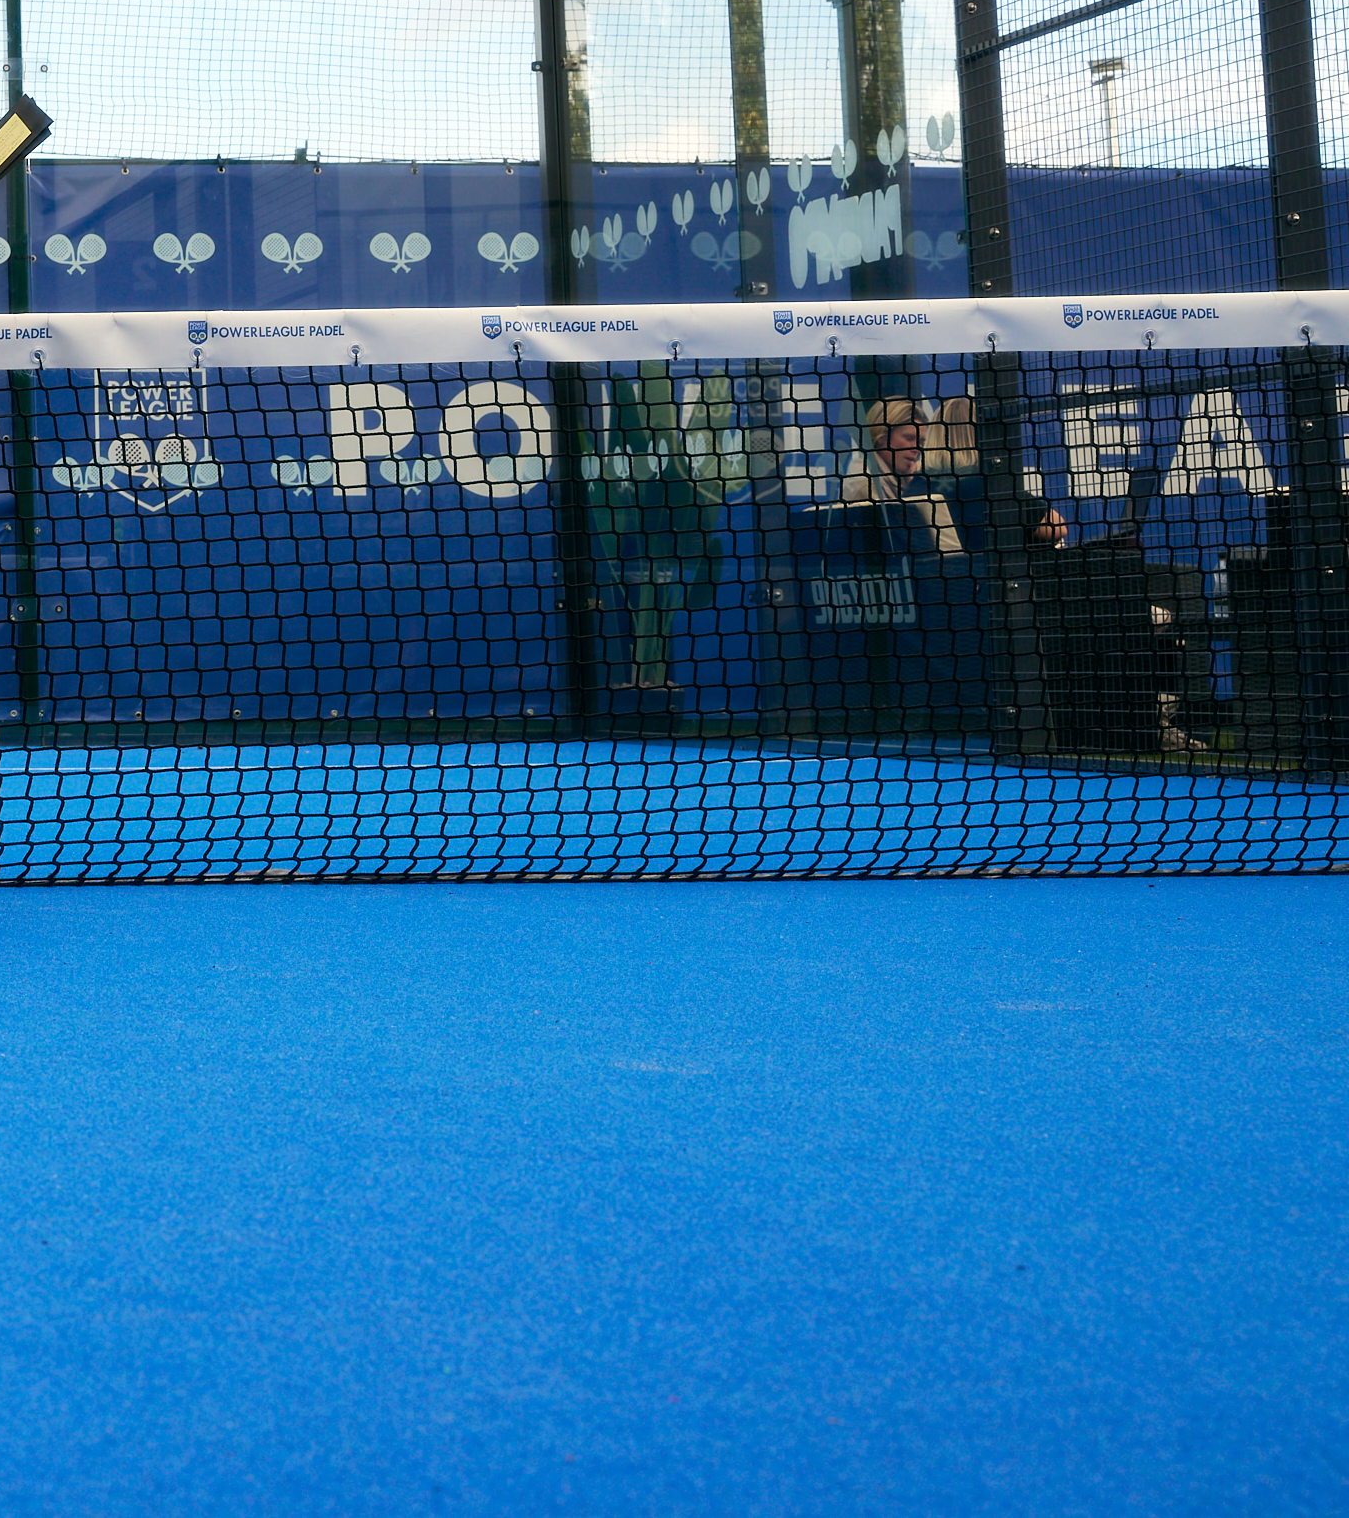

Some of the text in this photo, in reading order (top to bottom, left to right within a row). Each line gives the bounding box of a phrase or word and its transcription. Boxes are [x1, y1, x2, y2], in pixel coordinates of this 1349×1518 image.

[796, 313, 931, 328] POWERLEAGUE PADEL
[1086, 308, 1220, 321] POWERLEAGUE PADEL
[211, 325, 345, 339] POWERLEAGUE PADEL
[505, 320, 639, 333] POWERLEAGUE PADEL
[15, 328, 53, 340] PADEL
[107, 380, 193, 401] POWER
[108, 400, 194, 421] LEAGUE
